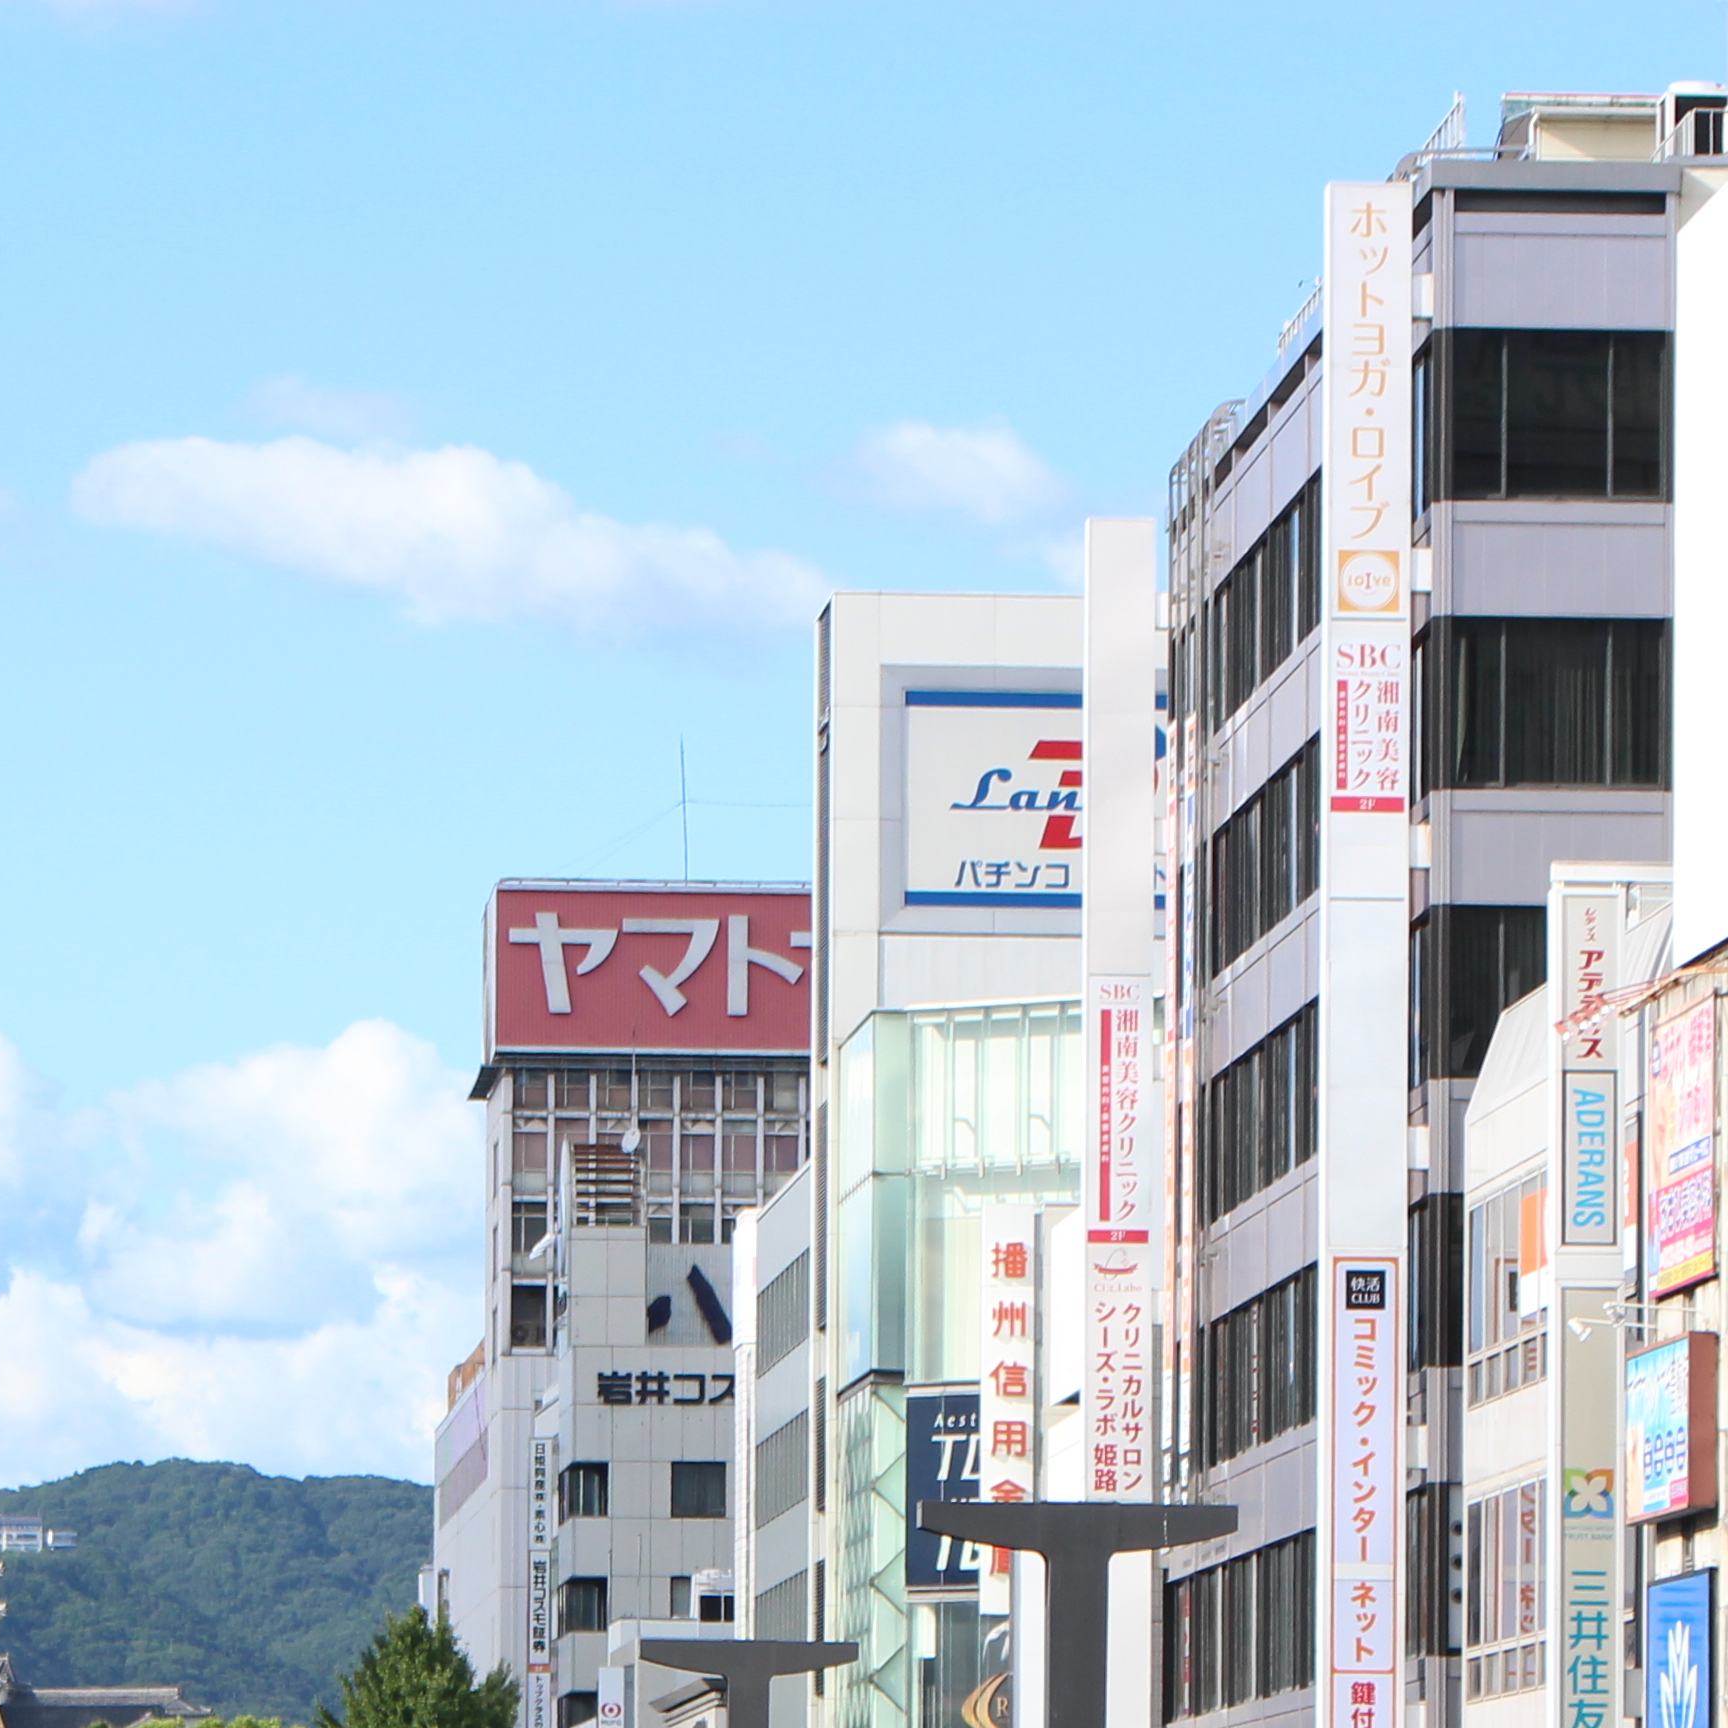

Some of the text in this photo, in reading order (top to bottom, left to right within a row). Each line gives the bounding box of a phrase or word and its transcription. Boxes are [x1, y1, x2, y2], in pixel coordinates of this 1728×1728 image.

[1348, 200, 1392, 540] ホットヨガ・ロイブ
[1336, 642, 1402, 670] SBC
[1352, 680, 1374, 790] クリニック
[1375, 680, 1401, 792] 湘南美容
[955, 859, 1071, 889] パチンコ
[508, 910, 812, 1017] ヤマト
[1099, 984, 1142, 1001] SBC
[1577, 949, 1605, 1060] アデス
[1115, 1008, 1140, 1223] 湘南美容クリニック
[1572, 1087, 1606, 1228] ADERANS
[1350, 1276, 1381, 1292] 快活
[1350, 1292, 1381, 1304] CLUB
[933, 1413, 977, 1429] Aest
[989, 1241, 1030, 1576] 播州信用金
[1120, 1302, 1145, 1493] クリニカルサロン
[1092, 1439, 1119, 1494] 姫路
[1350, 1316, 1379, 1663] コミック・インターネット
[532, 1560, 548, 1655] 岩井コスモ証券
